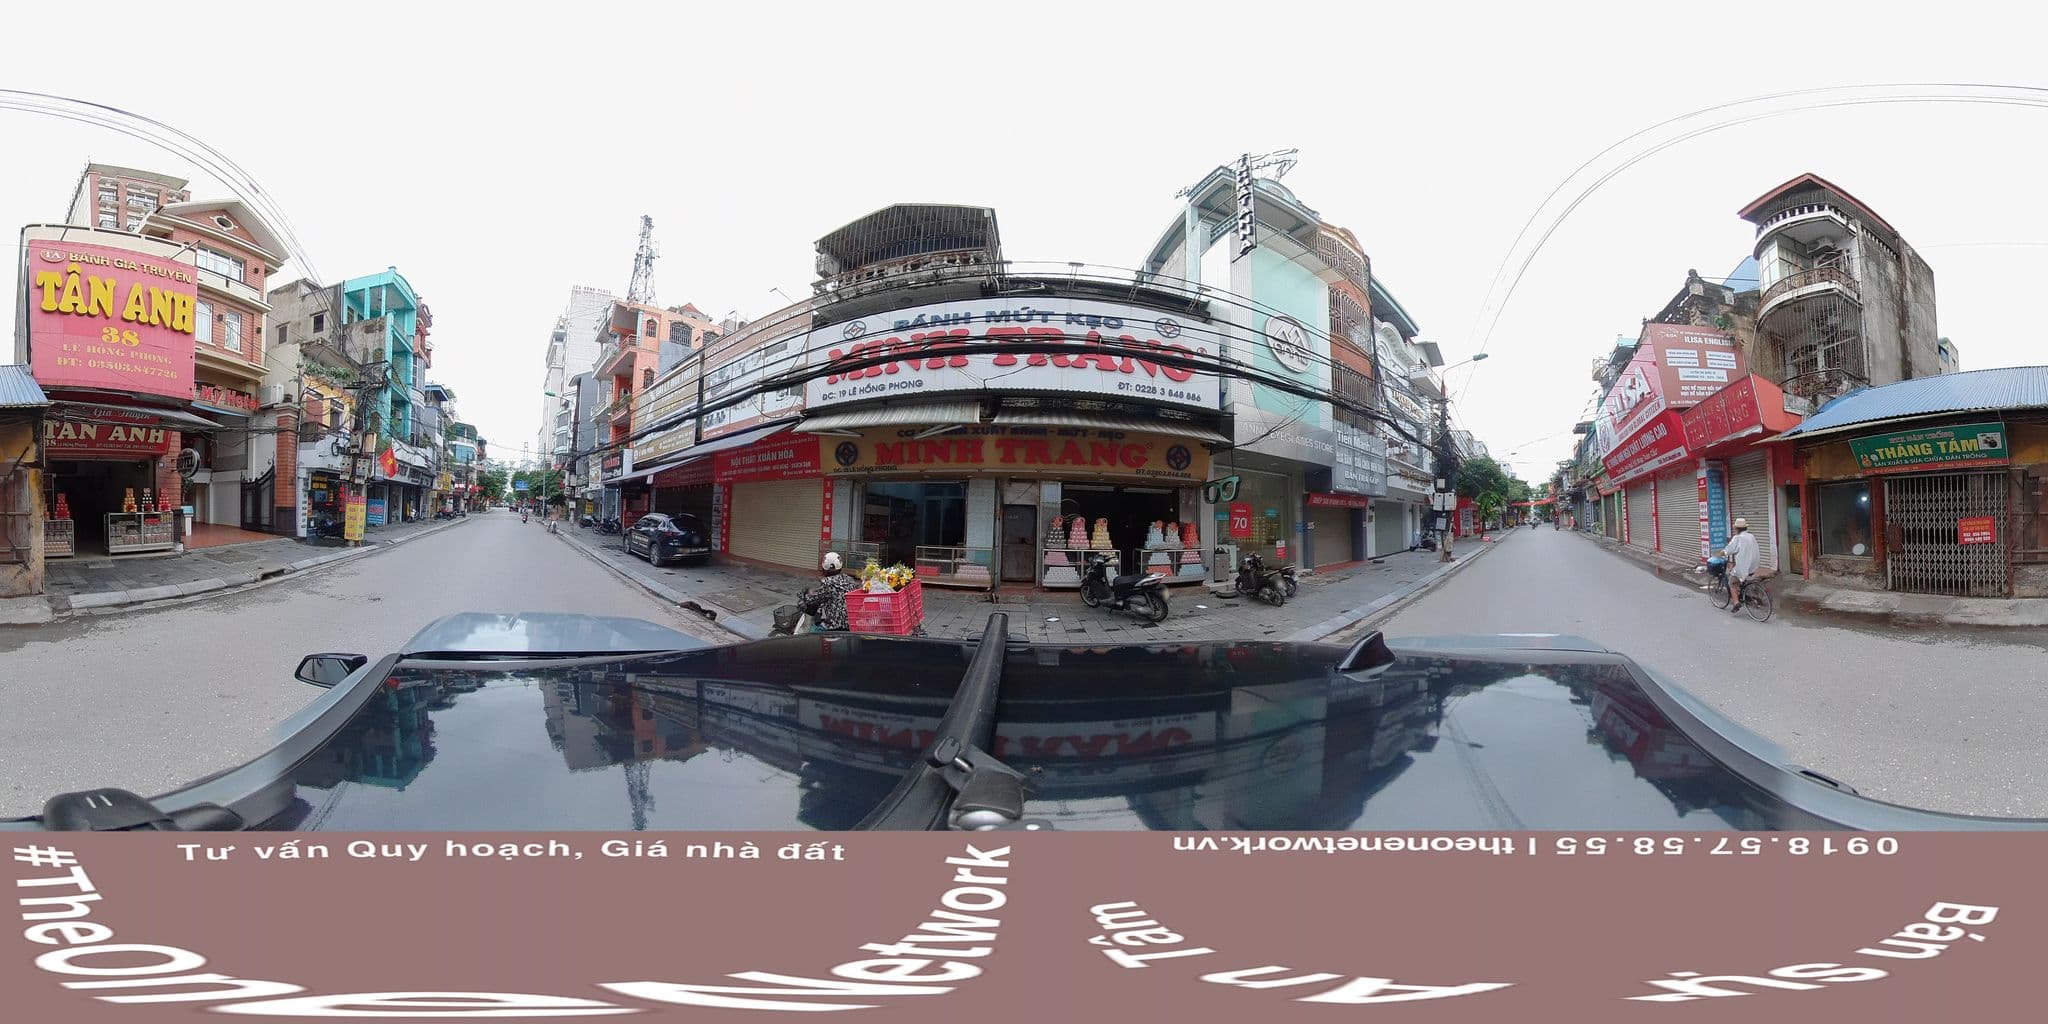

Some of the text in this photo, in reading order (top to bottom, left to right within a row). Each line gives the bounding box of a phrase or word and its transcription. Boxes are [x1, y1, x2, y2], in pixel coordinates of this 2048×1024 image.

[114, 257, 139, 272] GIA
[35, 262, 196, 334] TÂN ANH
[894, 306, 1124, 332] BÁNH MỨT KẸO
[101, 326, 140, 347] 38
[826, 326, 1196, 385] MINH TRANG
[838, 389, 847, 398] 19
[888, 379, 924, 390] PHONG
[1135, 383, 1158, 395] 0228
[1159, 387, 1166, 395] 3
[108, 426, 165, 443] ANH
[873, 438, 1150, 469] MINH TRANG
[1314, 440, 1336, 454] STORE
[1936, 436, 1981, 454] TÁM
[1233, 517, 1248, 529] 70
